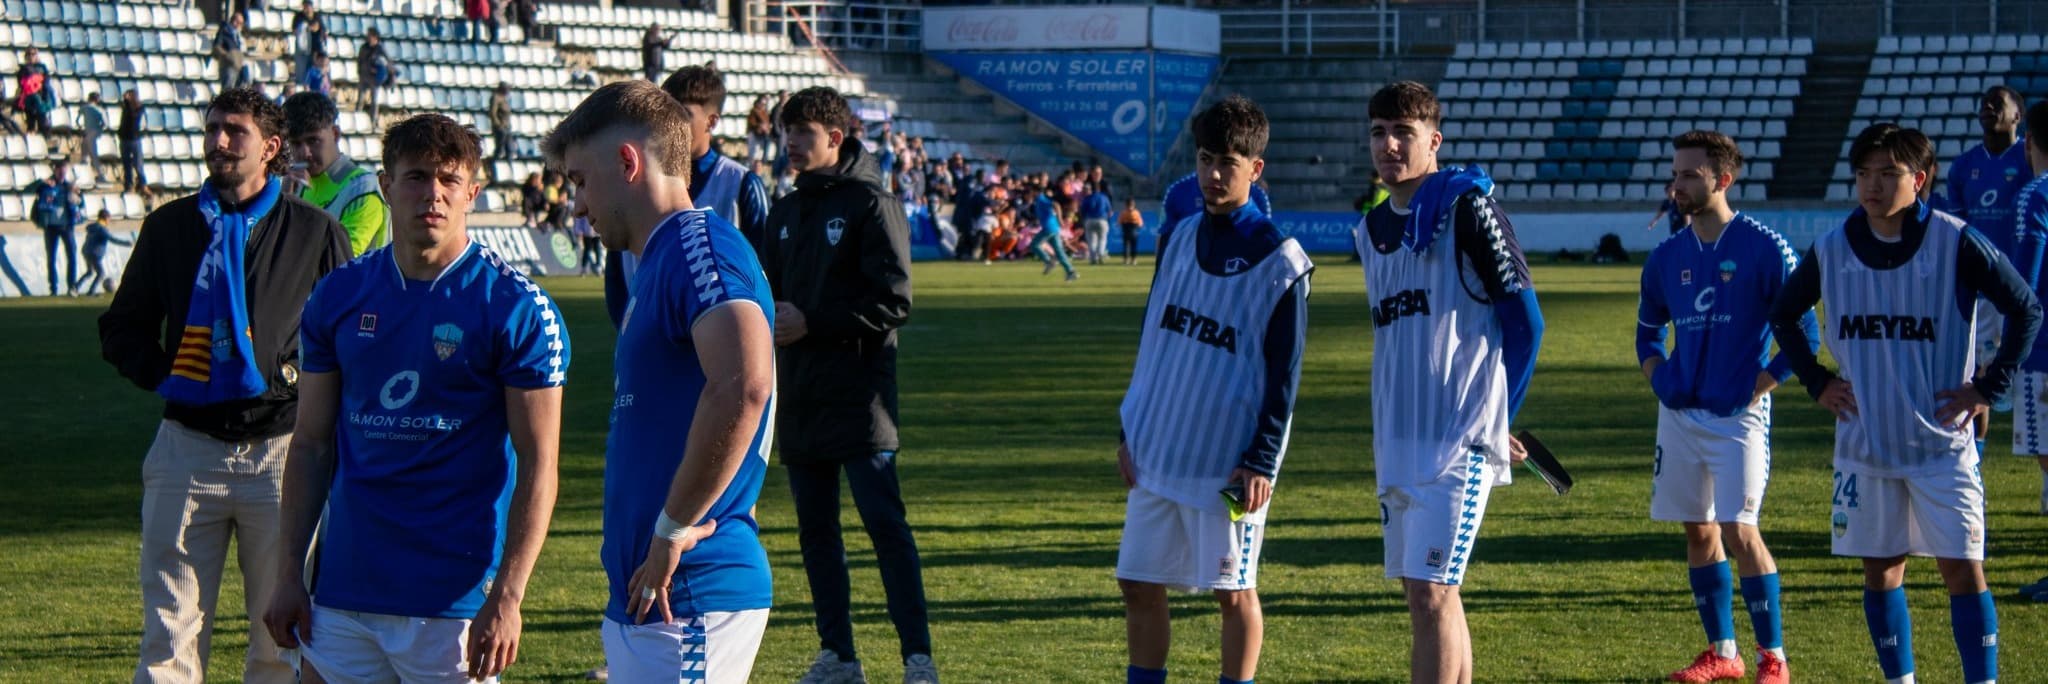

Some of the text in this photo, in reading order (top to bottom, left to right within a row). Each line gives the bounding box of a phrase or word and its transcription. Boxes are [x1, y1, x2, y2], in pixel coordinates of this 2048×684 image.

[978, 60, 1146, 75] RAMON SOLER
[1007, 80, 1054, 92] Ferros
[1067, 80, 1137, 92] Ferreteria
[1839, 314, 1937, 343] MEYBA
[400, 415, 462, 430] SOLER
[1832, 471, 1859, 508] 24
